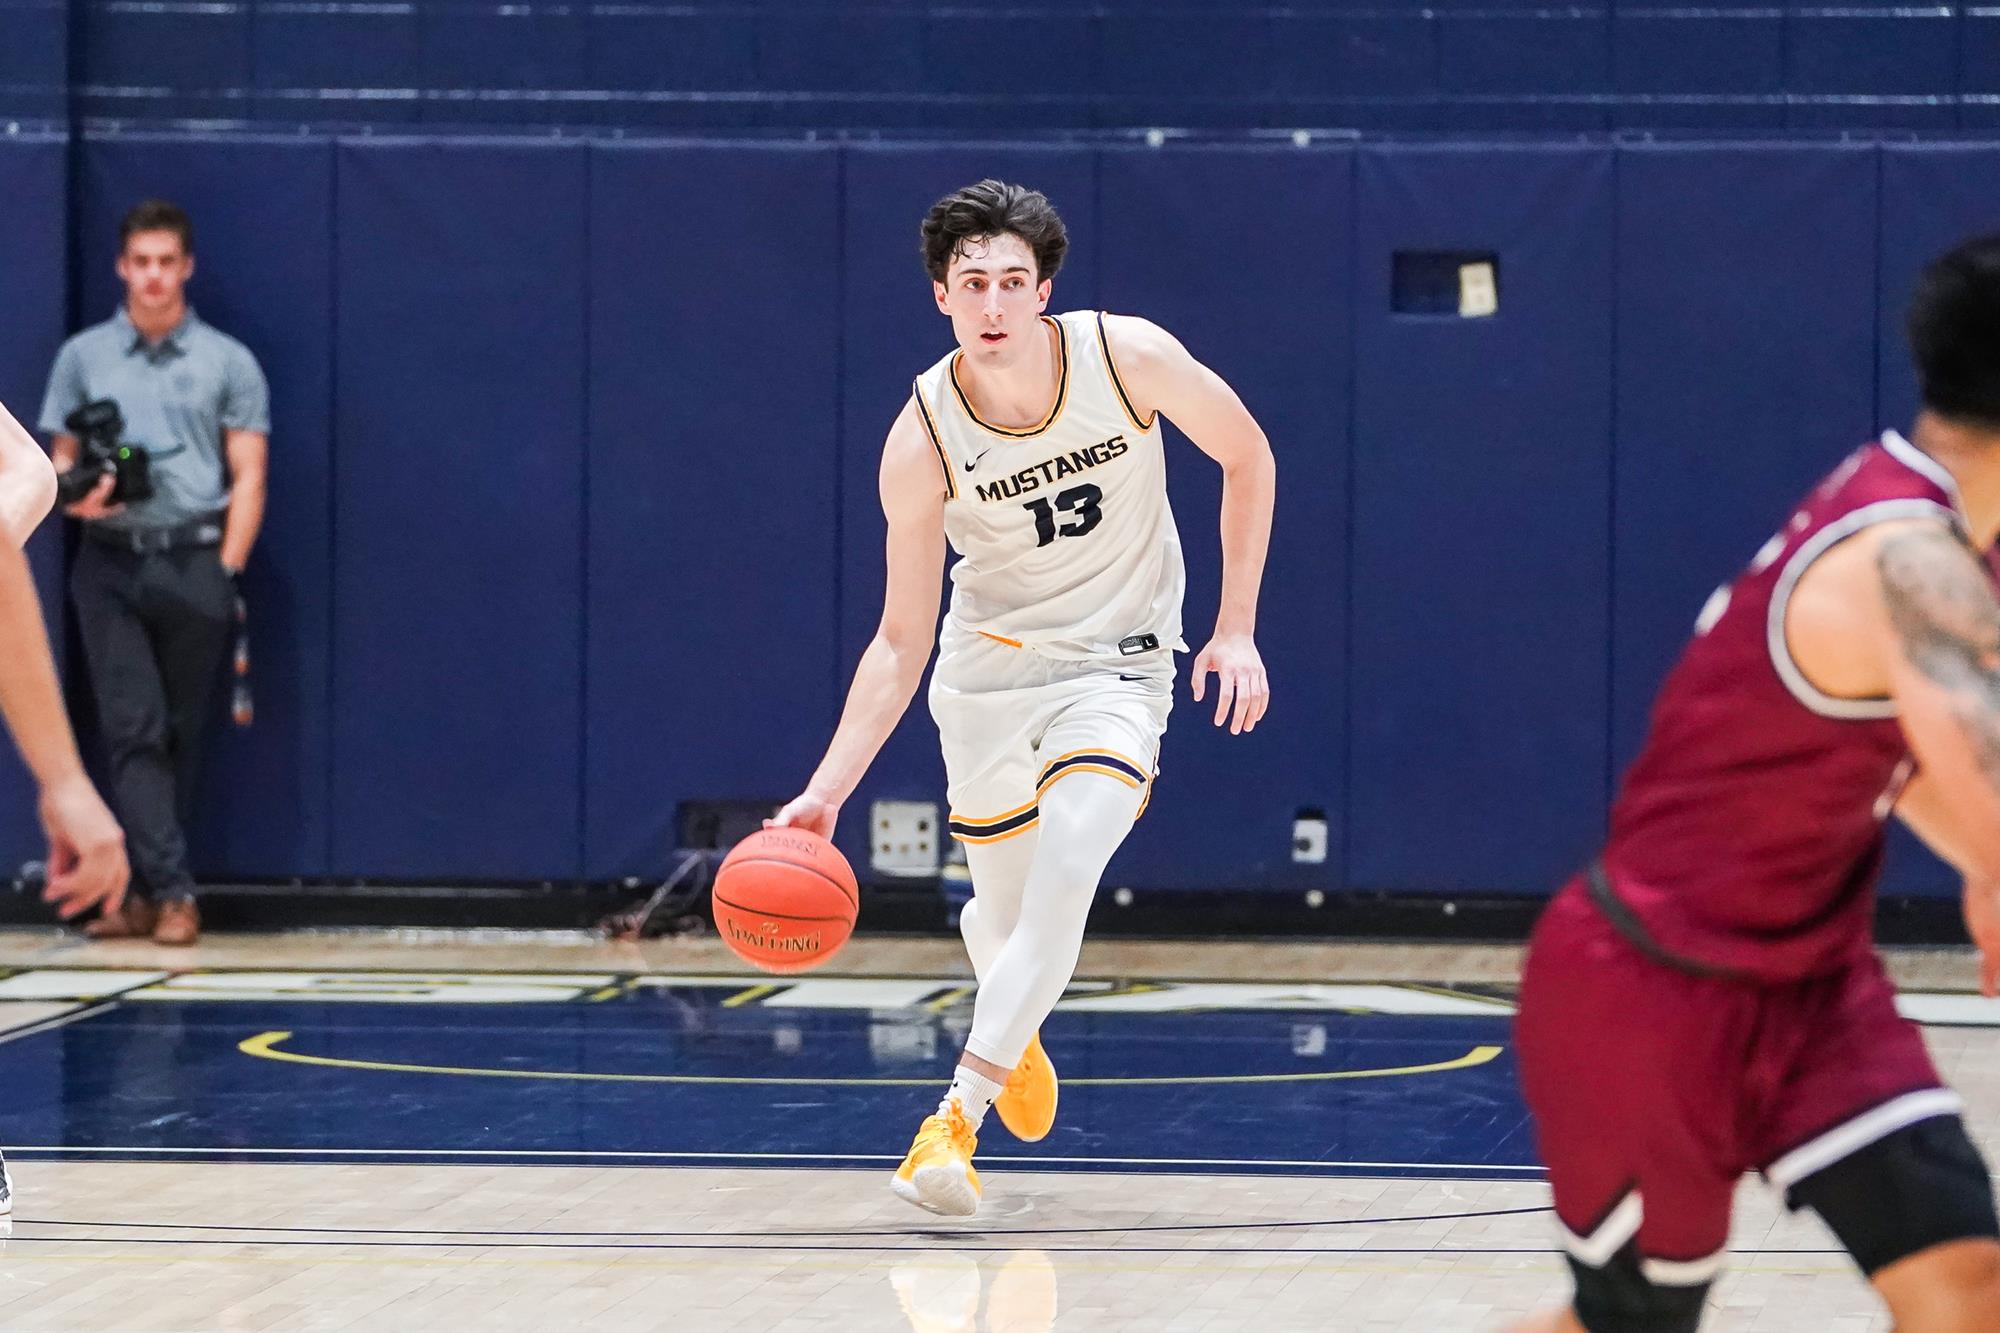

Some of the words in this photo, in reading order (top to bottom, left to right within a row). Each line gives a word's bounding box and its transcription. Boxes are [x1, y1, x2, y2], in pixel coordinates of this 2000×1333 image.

[975, 434, 1129, 502] MUSTANGS
[1022, 482, 1104, 548] 13
[1145, 639, 1153, 647] L
[727, 918, 821, 952] SPALDING
